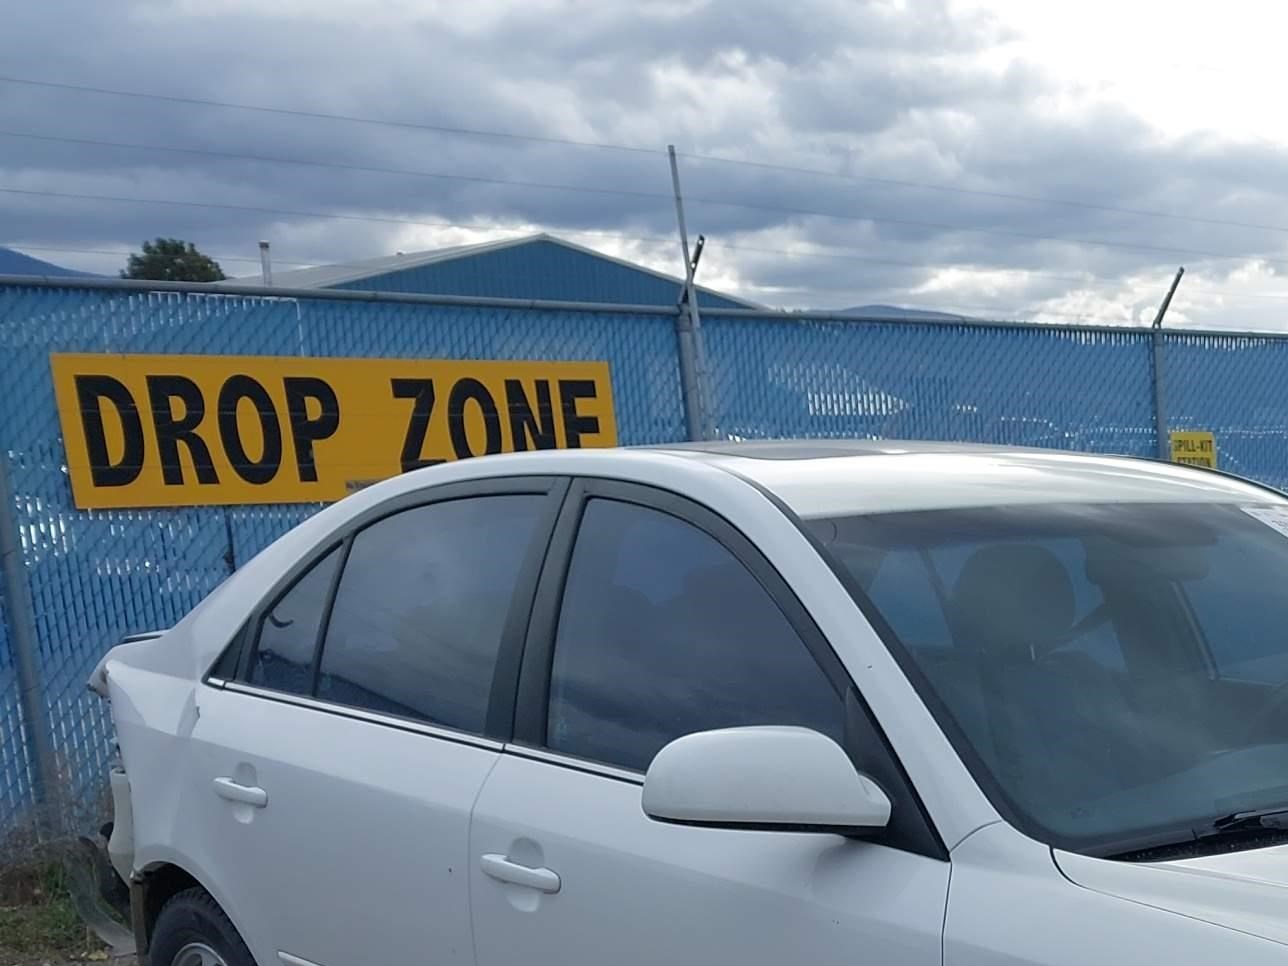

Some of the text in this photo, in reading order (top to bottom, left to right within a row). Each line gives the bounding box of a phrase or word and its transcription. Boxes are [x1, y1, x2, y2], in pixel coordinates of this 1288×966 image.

[74, 374, 600, 487] DROP ZONE
[1174, 439, 1213, 452] SPILL-KIT
